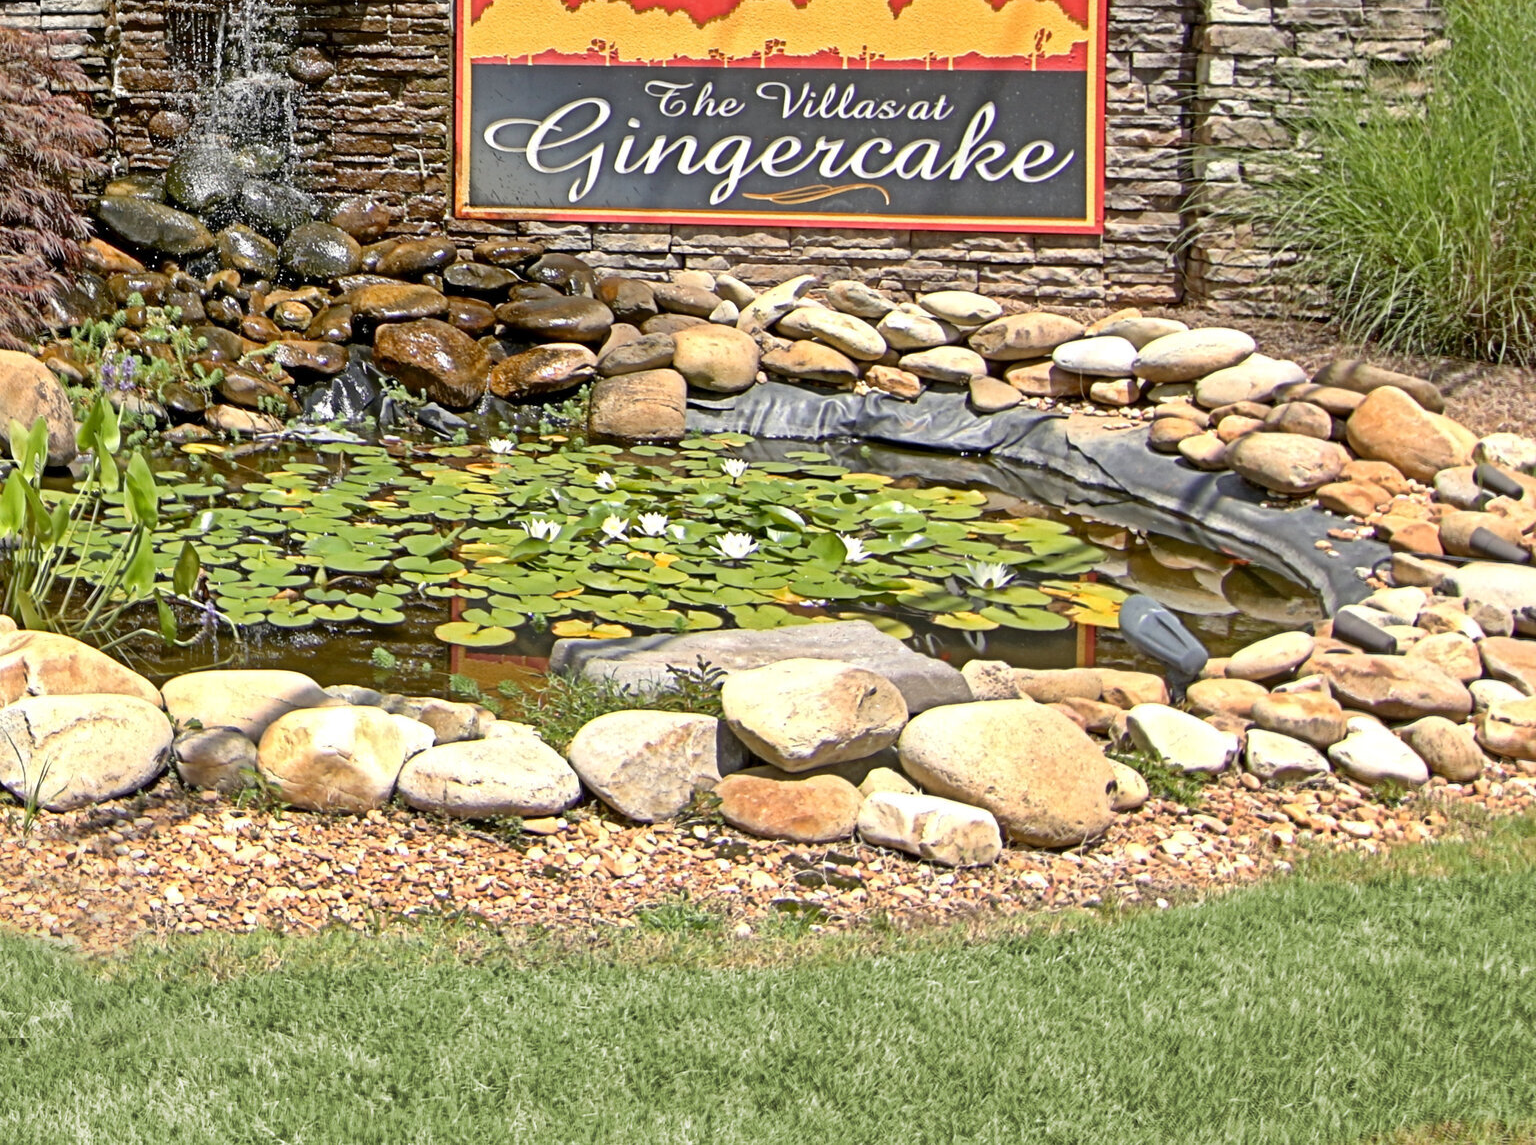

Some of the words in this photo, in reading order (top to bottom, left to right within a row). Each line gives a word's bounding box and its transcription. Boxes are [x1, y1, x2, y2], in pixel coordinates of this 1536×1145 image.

[645, 79, 744, 118] The
[756, 81, 910, 121] Villas
[908, 93, 953, 121] at
[483, 97, 1074, 205] Gingercake
